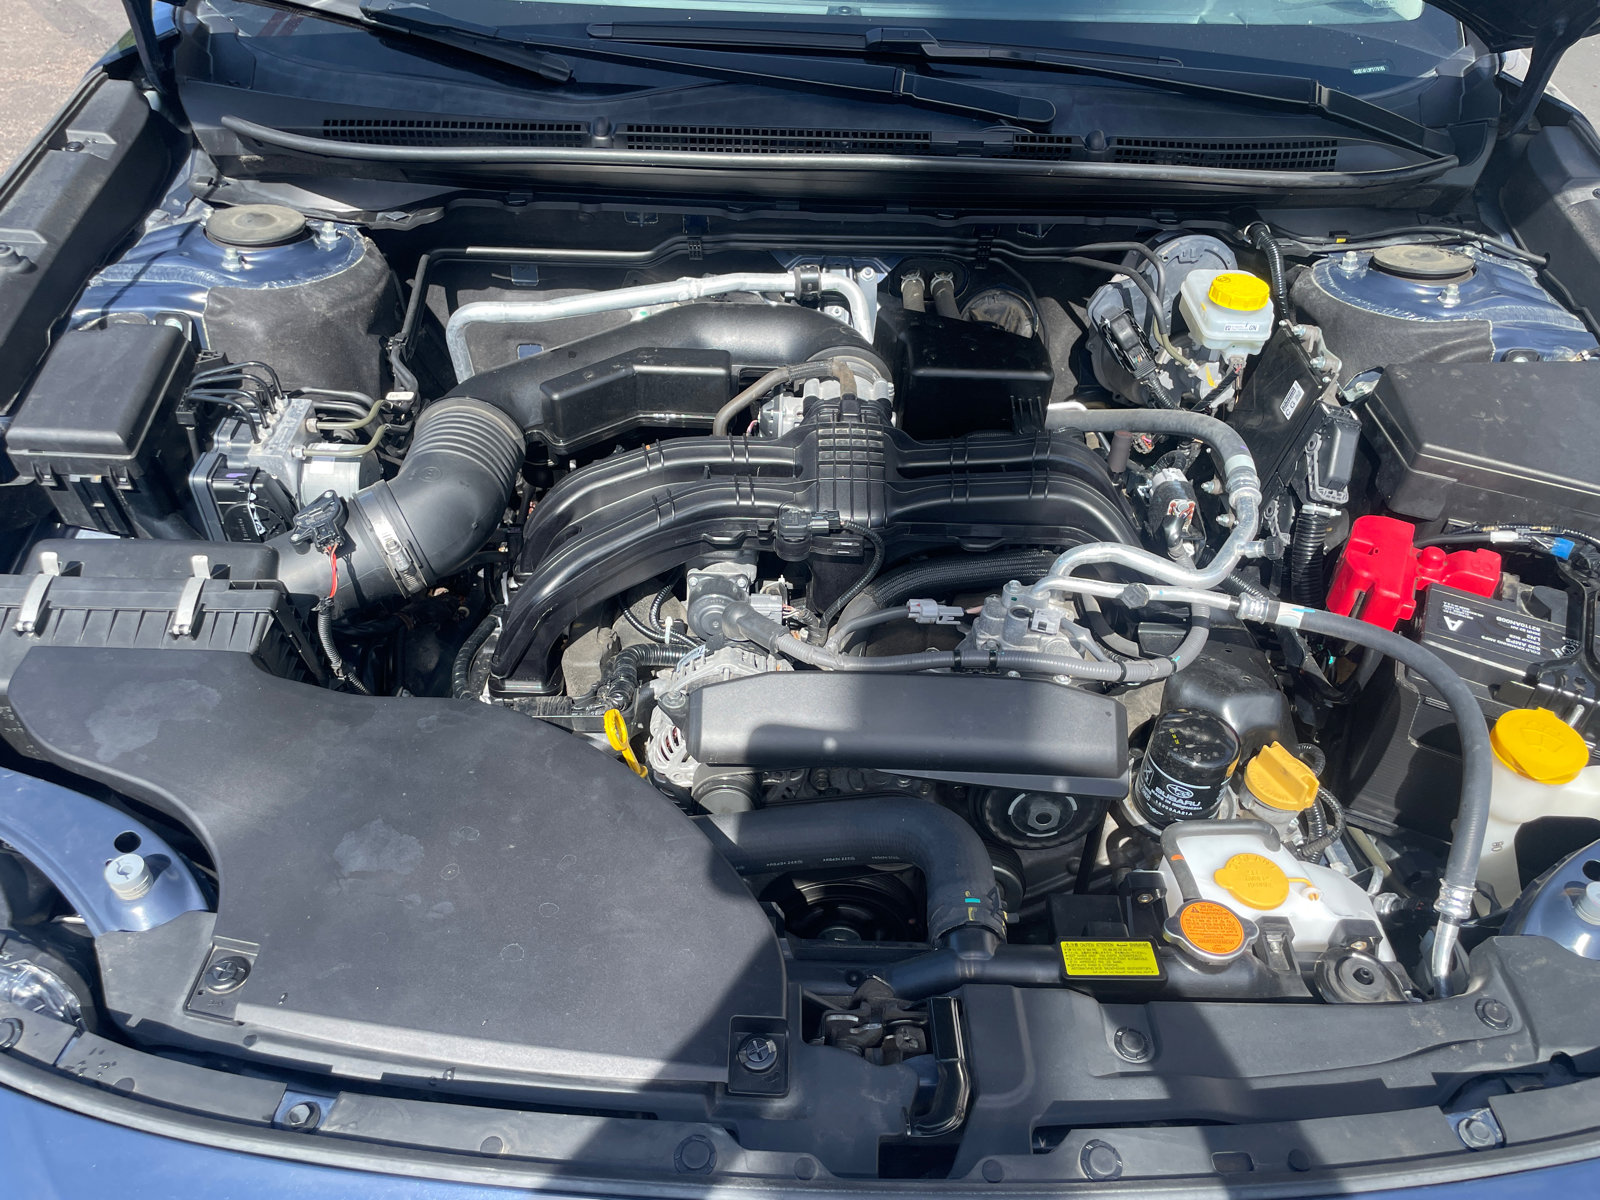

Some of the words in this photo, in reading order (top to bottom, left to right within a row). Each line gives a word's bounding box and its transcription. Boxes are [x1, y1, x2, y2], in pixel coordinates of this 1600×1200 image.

[1497, 640, 1524, 650] CRANKING
[1505, 638, 1526, 646] AMPS
[1156, 787, 1200, 807] SUBARU
